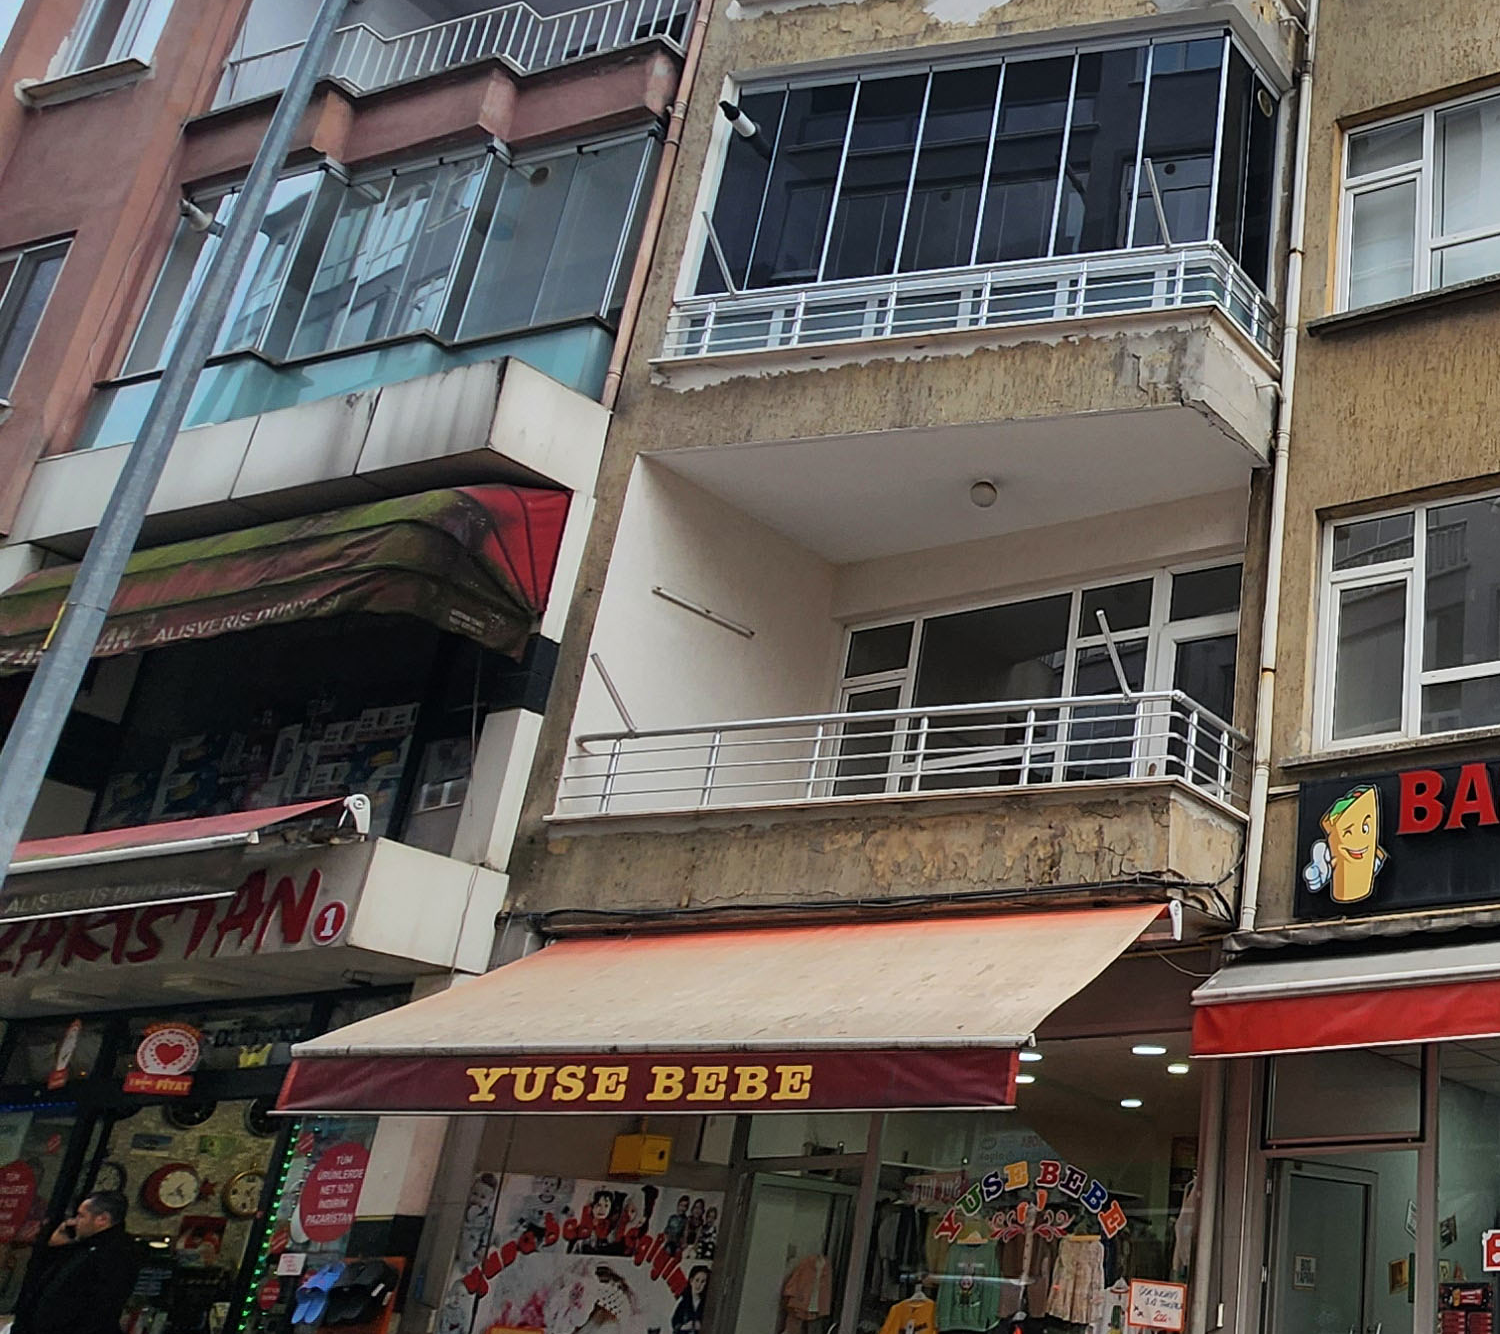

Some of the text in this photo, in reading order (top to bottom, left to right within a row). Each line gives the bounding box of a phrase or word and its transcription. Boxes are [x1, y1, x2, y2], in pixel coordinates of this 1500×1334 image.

[466, 1065, 813, 1102] YUSE BEBE
[934, 1160, 1128, 1243] YUSE BEBE
